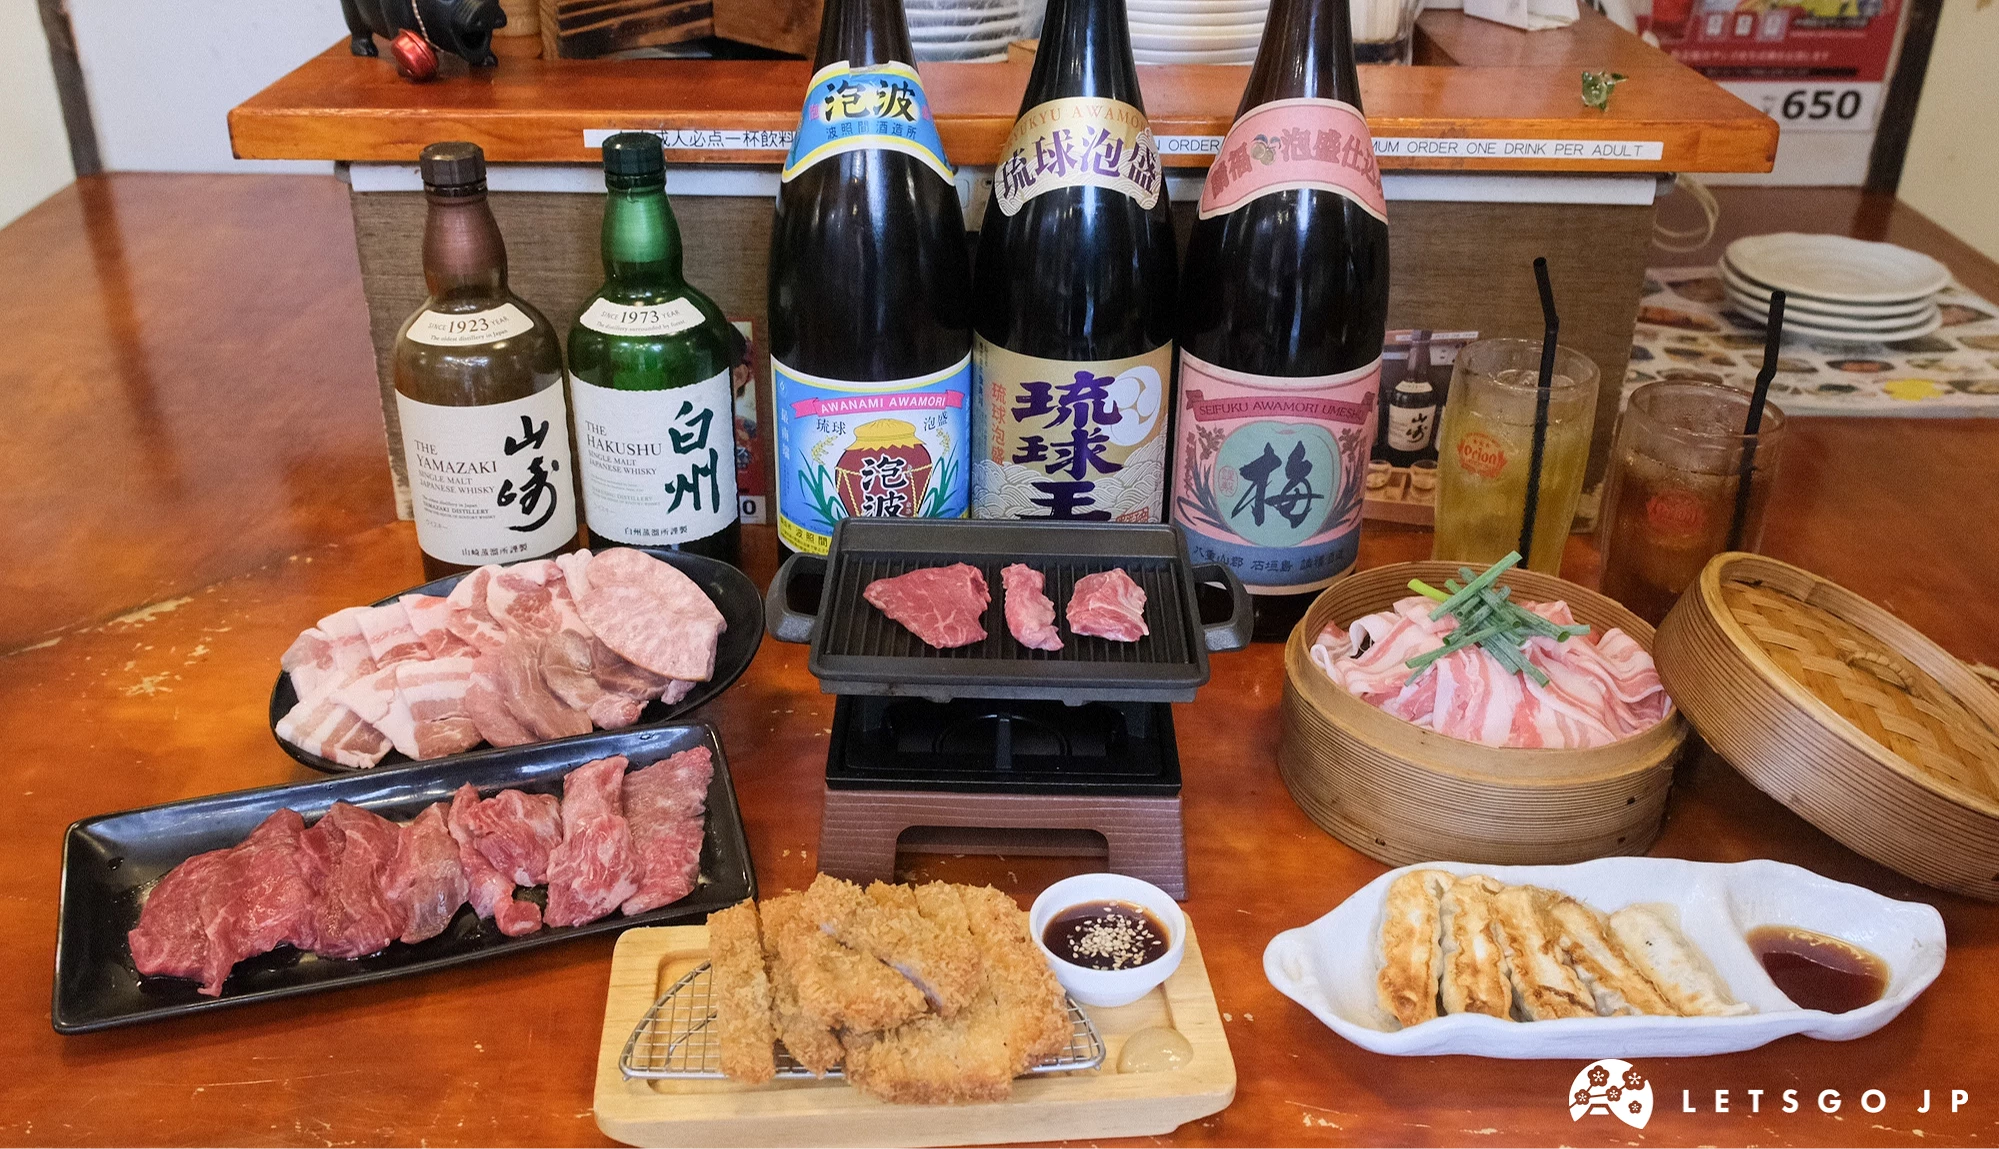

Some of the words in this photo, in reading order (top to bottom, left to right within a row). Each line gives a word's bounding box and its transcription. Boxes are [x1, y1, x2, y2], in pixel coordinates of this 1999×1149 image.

[824, 79, 917, 122] 泡波
[1782, 90, 1862, 120] 650
[1072, 105, 1149, 135] AWAMOR
[619, 130, 795, 148] 成人必点一杯飲料
[1168, 138, 1221, 152] ORDER
[1406, 140, 1459, 154] ORDER
[1466, 141, 1497, 155] ONE
[1504, 142, 1547, 155] DRINK
[1554, 143, 1584, 156] PER
[1591, 144, 1643, 157] ADULT
[1002, 125, 1157, 200] 琉球泡盛
[1281, 127, 1381, 192] 泡盛仕込
[428, 322, 447, 331] SINCE
[448, 317, 490, 334] 1923
[491, 315, 510, 327] YEAR
[601, 310, 618, 320] SINCE
[620, 310, 660, 324] 1973
[662, 309, 681, 319] YEAR
[820, 397, 884, 414] AWANAMI
[888, 396, 947, 408] AWAMORI
[1199, 402, 1249, 416] SEIFUKU
[1252, 401, 1319, 414] AWAMORI
[585, 420, 607, 436] THE
[816, 417, 847, 436] 琉球
[923, 411, 949, 431] 泡盛
[991, 381, 1007, 467] 琉球泡盛
[413, 439, 438, 456] THE
[587, 434, 663, 456] HAKUSHU
[1010, 370, 1124, 521] 琉球王
[416, 453, 497, 475] YAMAZAKI
[588, 449, 612, 463] SINGLE
[614, 457, 637, 466] MALT
[589, 458, 622, 474] JAPANESE
[623, 467, 657, 475] WHISKY
[664, 400, 720, 514] 白州
[419, 470, 445, 483] SINGLE
[447, 477, 473, 486] MALT
[420, 480, 457, 494] JAPANESE
[458, 486, 495, 495] WHISKY
[861, 453, 907, 517] 泡波
[1230, 440, 1325, 529] 梅
[1250, 559, 1294, 573] 石垣島
